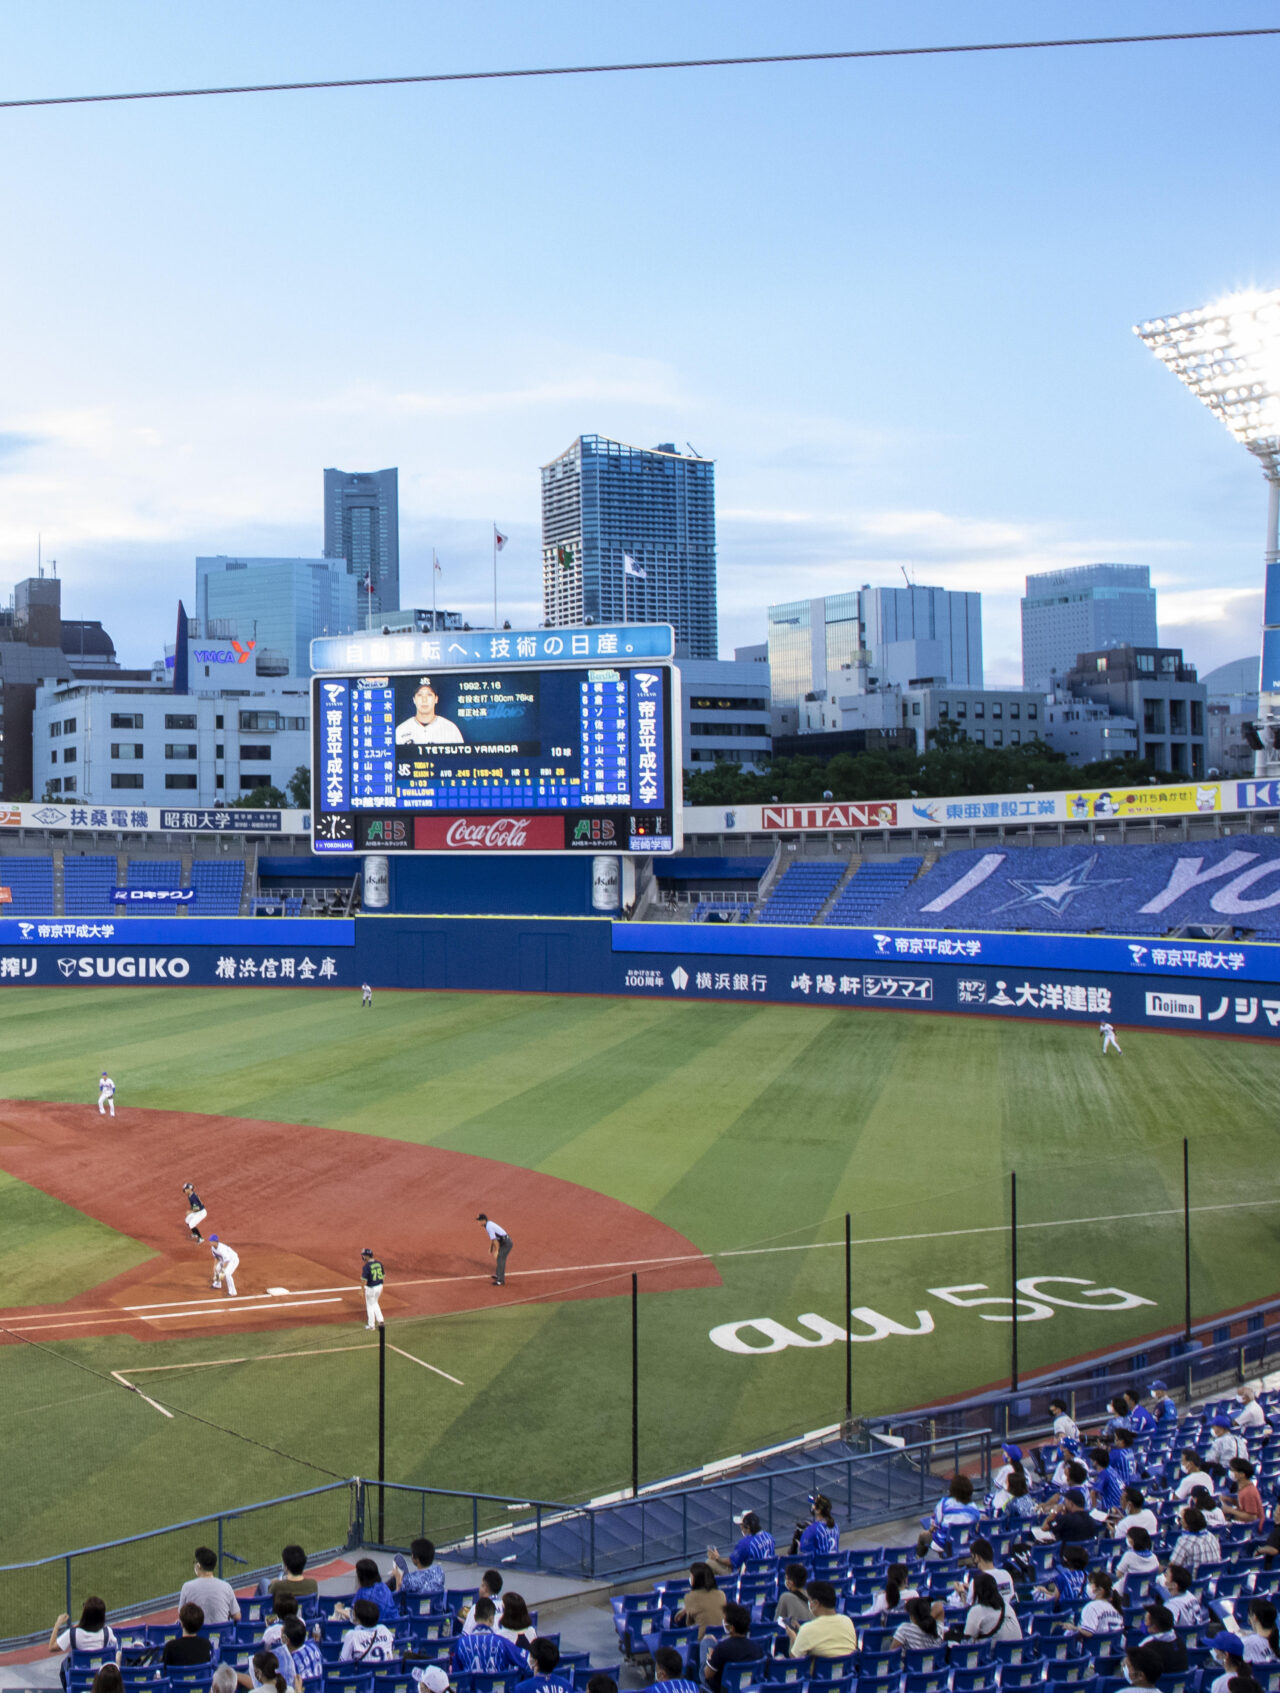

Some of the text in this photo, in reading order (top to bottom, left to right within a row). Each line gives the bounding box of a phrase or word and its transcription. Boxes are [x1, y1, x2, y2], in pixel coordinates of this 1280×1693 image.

[193, 650, 236, 664] YMCA
[326, 710, 344, 807] 帝京平成大学
[425, 745, 472, 755] TETSUTO
[474, 744, 519, 754] YAMADA
[638, 700, 657, 804] 帝京平成大学
[70, 808, 149, 828] 扶桑電機
[164, 811, 231, 829] 昭和大学
[764, 805, 871, 829] NITTAN
[945, 799, 1056, 820] 東亜建設工業
[130, 891, 194, 900] ロキテクノ
[38, 924, 115, 939] 帝京平成大学
[894, 937, 982, 956] 帝京平成大学
[78, 956, 190, 979] SUGIKO
[215, 955, 338, 980] 横浜信用金庫
[1151, 948, 1246, 970] 帝京平成大学
[624, 976, 664, 988] 100周年
[695, 971, 768, 992] 横浜銀行
[790, 972, 932, 998] 崎陽軒 シウマイ
[1014, 981, 1112, 1014] 大洋建設
[708, 1275, 1158, 1355] au 5G
